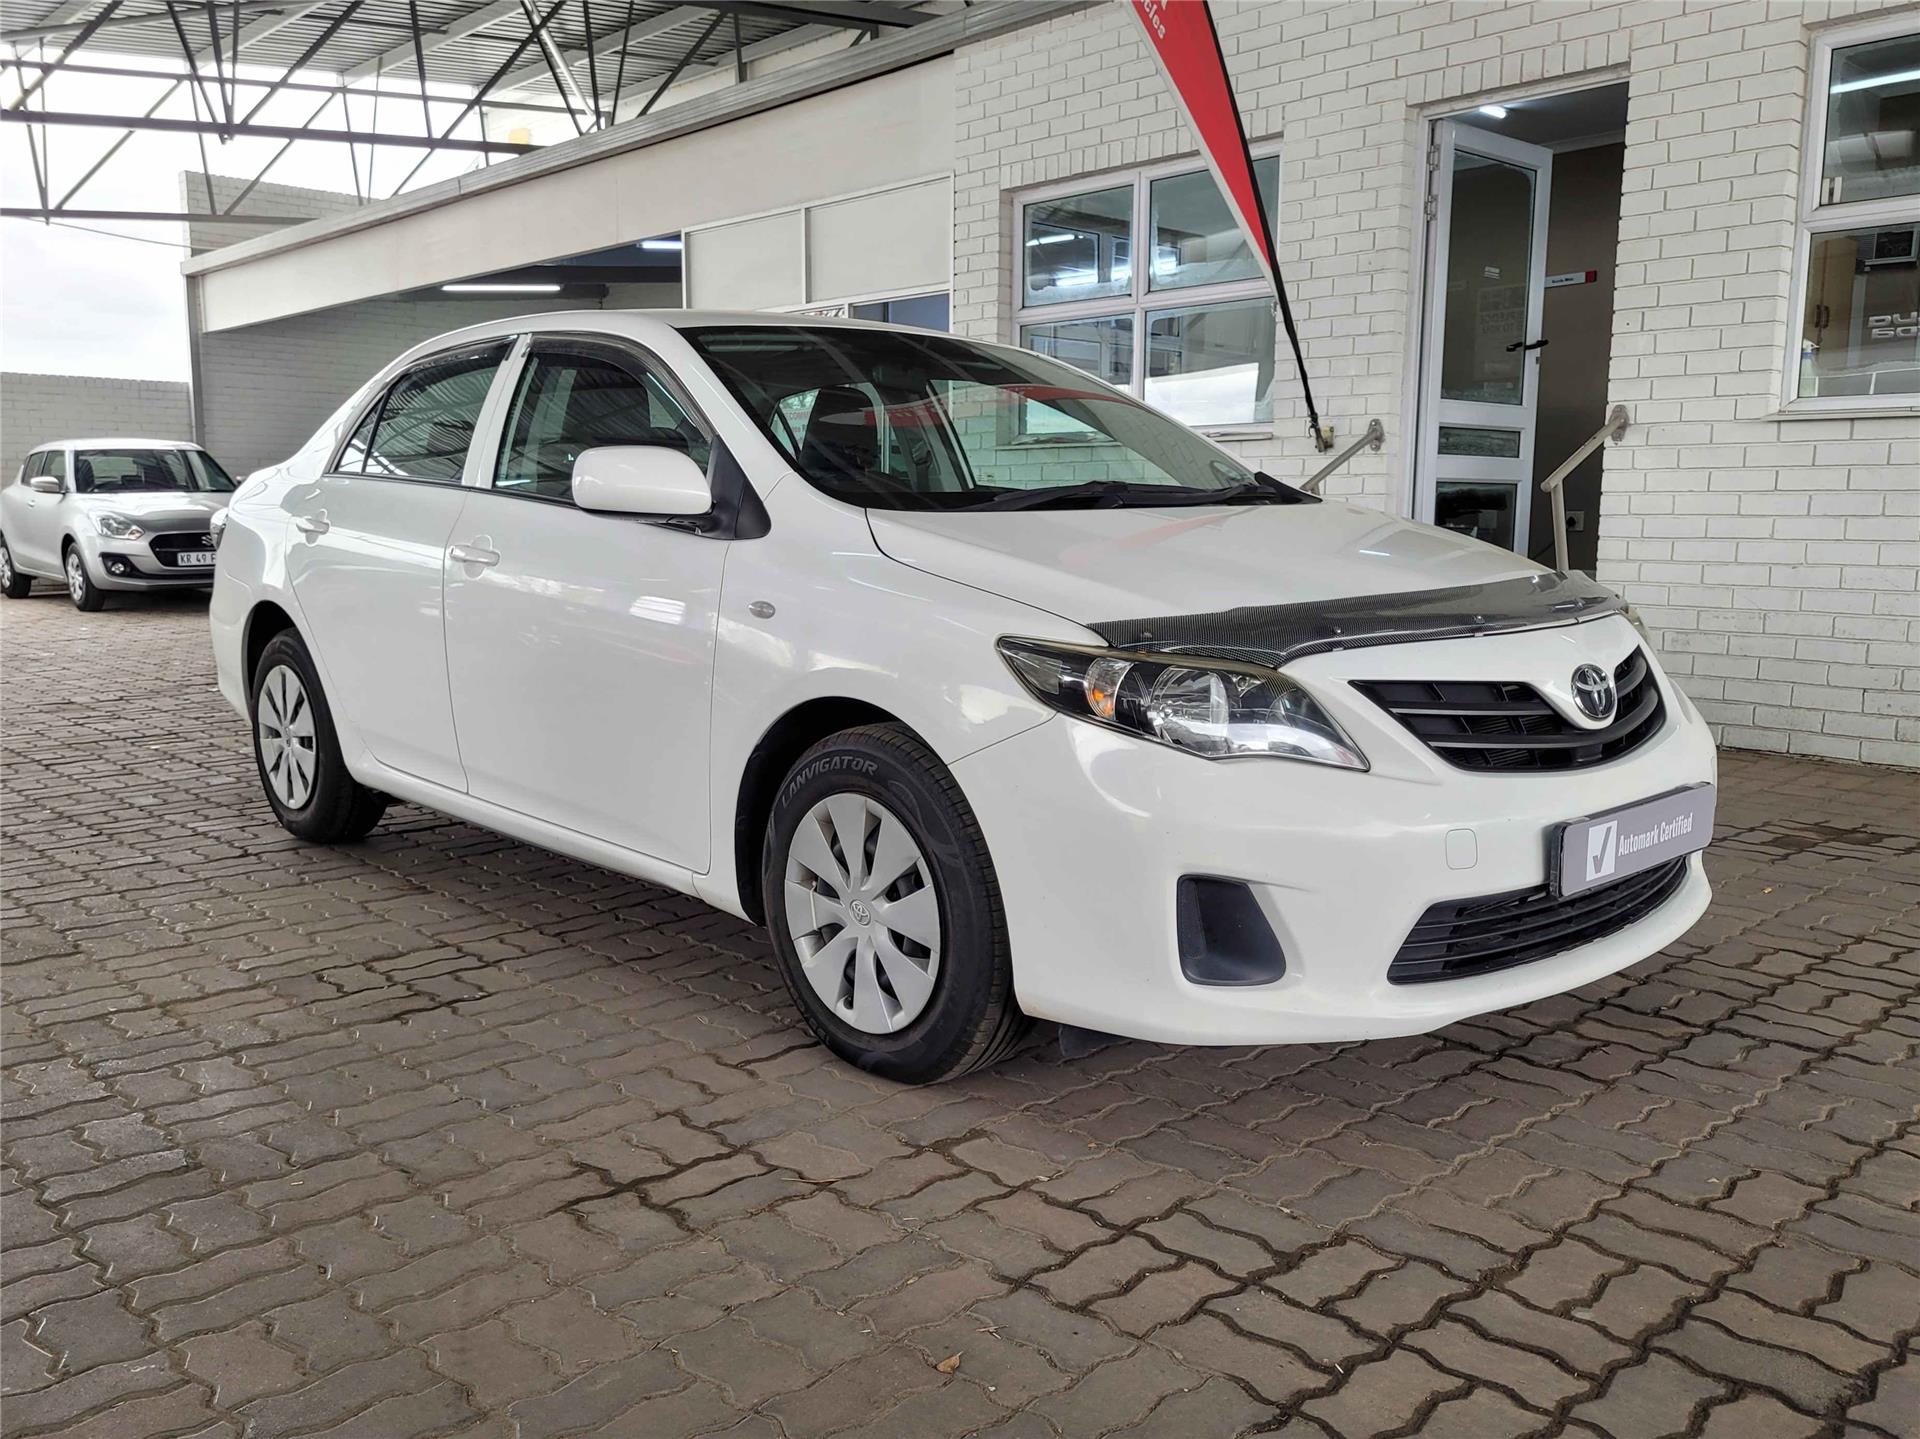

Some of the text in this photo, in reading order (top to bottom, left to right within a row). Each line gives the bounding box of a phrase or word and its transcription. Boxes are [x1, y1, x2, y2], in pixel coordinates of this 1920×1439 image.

[1141, 0, 1166, 39] cles
[180, 554, 192, 564] KR
[782, 756, 878, 808] LANVIGATOR
[1618, 812, 1693, 856] Automark Certified
